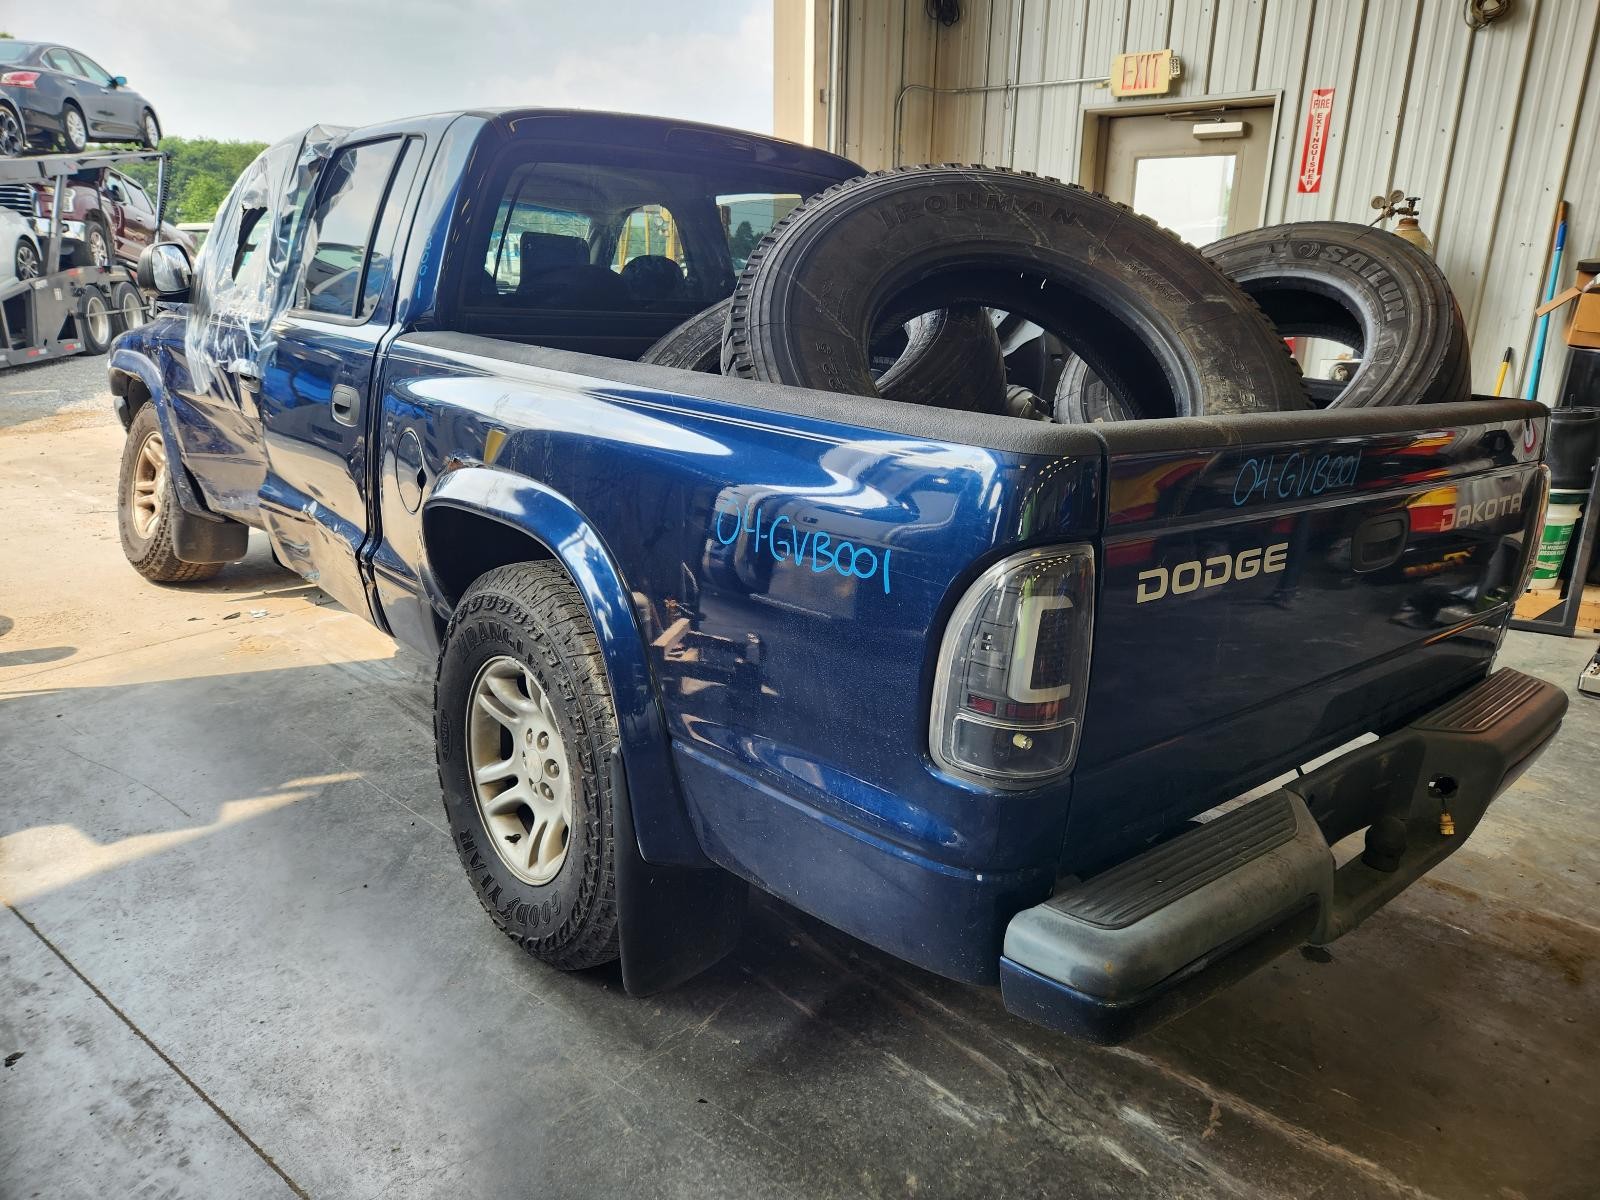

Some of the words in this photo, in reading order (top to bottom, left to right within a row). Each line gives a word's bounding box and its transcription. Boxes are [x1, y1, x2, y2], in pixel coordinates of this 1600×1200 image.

[1121, 52, 1164, 90] EXIT
[1312, 98, 1331, 109] FIRE
[1306, 112, 1324, 186] EXTINGUISHER
[877, 190, 1081, 230] IRONMAN
[1233, 450, 1361, 507] 04-GVB001
[1440, 492, 1523, 532] DAKOTA
[714, 501, 891, 594] 04-GVB001
[1136, 541, 1289, 604] DODGE
